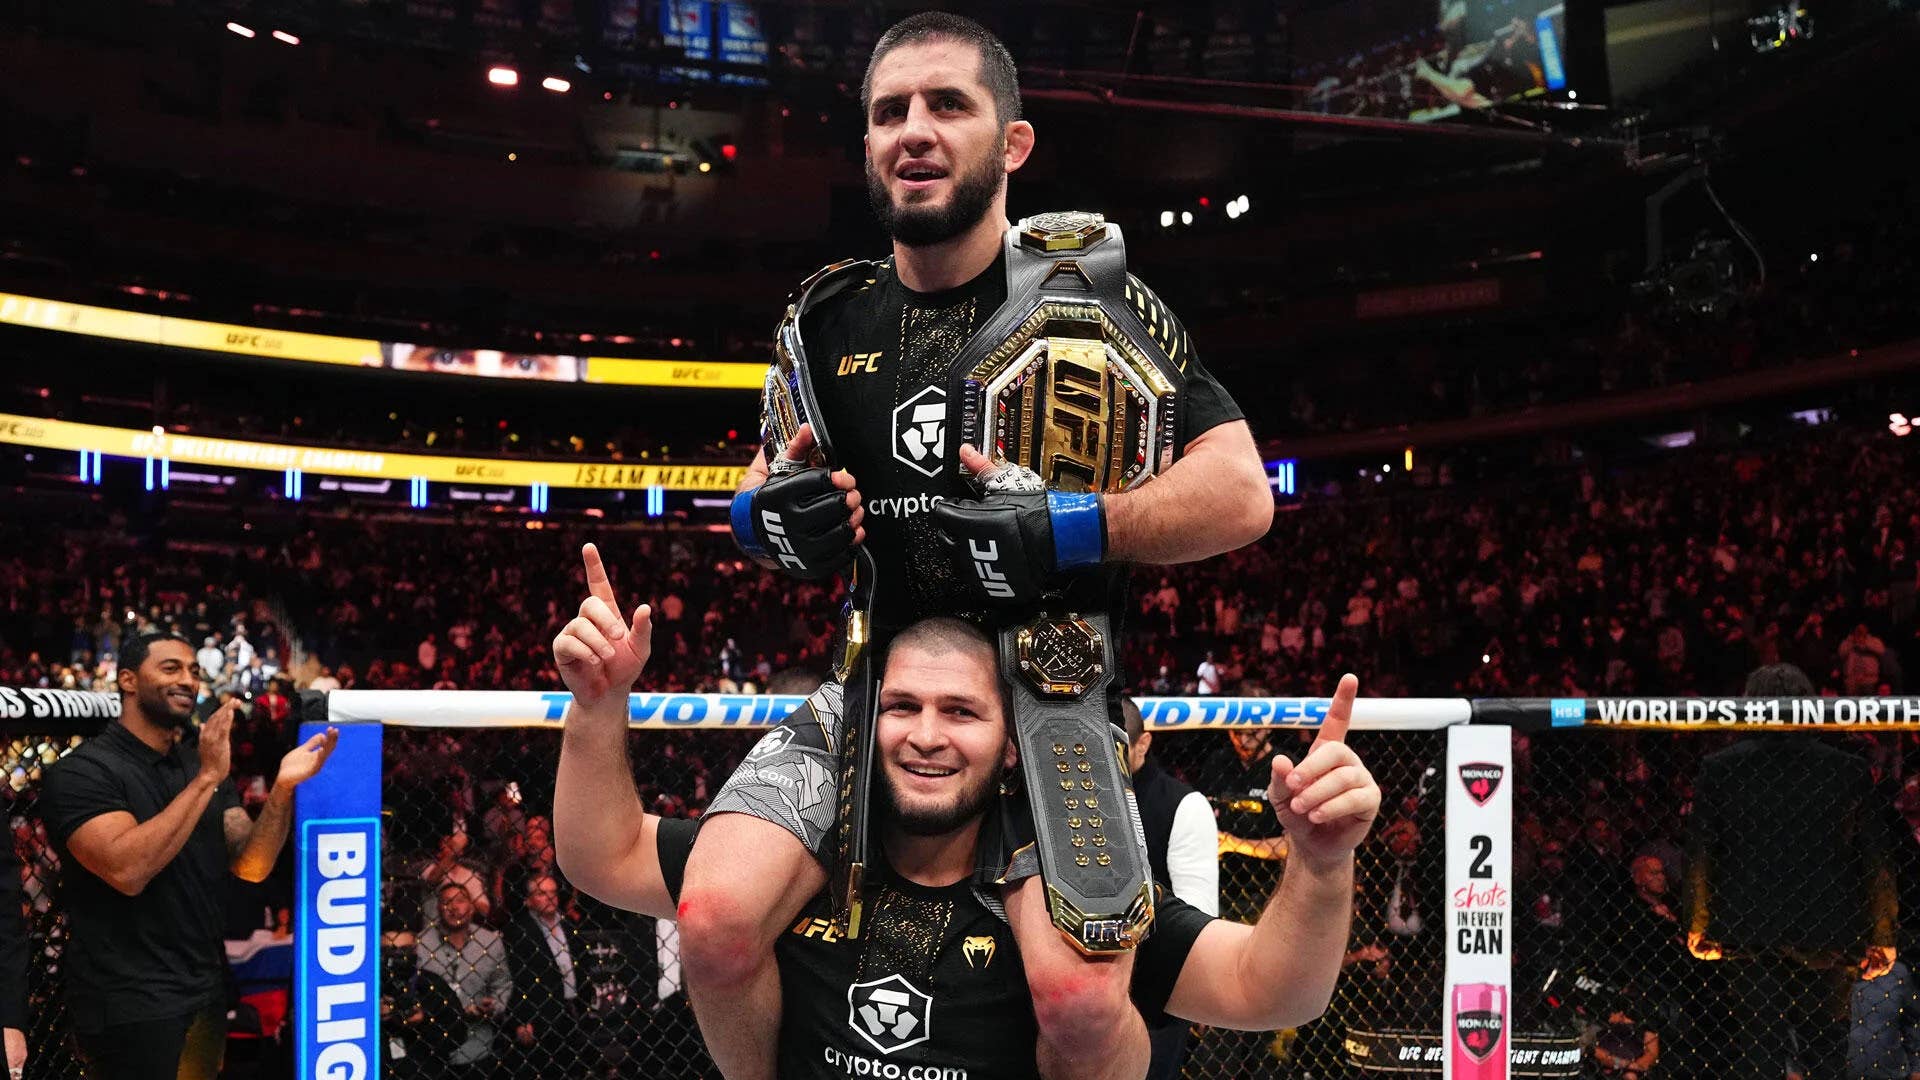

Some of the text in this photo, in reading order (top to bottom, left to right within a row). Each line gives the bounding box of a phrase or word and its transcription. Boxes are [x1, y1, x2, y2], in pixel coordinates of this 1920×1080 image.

[837, 351, 883, 376] UFC
[455, 465, 486, 477] UFC
[575, 465, 645, 485] ISLAM
[995, 470, 1013, 484] UFC
[761, 510, 807, 570] UFC
[968, 538, 1016, 597] UFC
[20, 687, 122, 718] STRONG
[1200, 701, 1332, 726] TIRES
[1555, 699, 1920, 726] HSS WORLD'S #1 IN ORTH
[1462, 768, 1502, 779] MONACO
[1469, 835, 1493, 878] 2
[1454, 882, 1507, 908] shots
[1083, 920, 1132, 943] UFC
[1457, 911, 1504, 928] IN EVERY
[1457, 929, 1504, 955] CAN
[315, 832, 368, 1080] BUD LIG
[1458, 1018, 1501, 1029] MONACO
[824, 1046, 968, 1080] crypto.com
[1399, 1046, 1421, 1060] UFC
